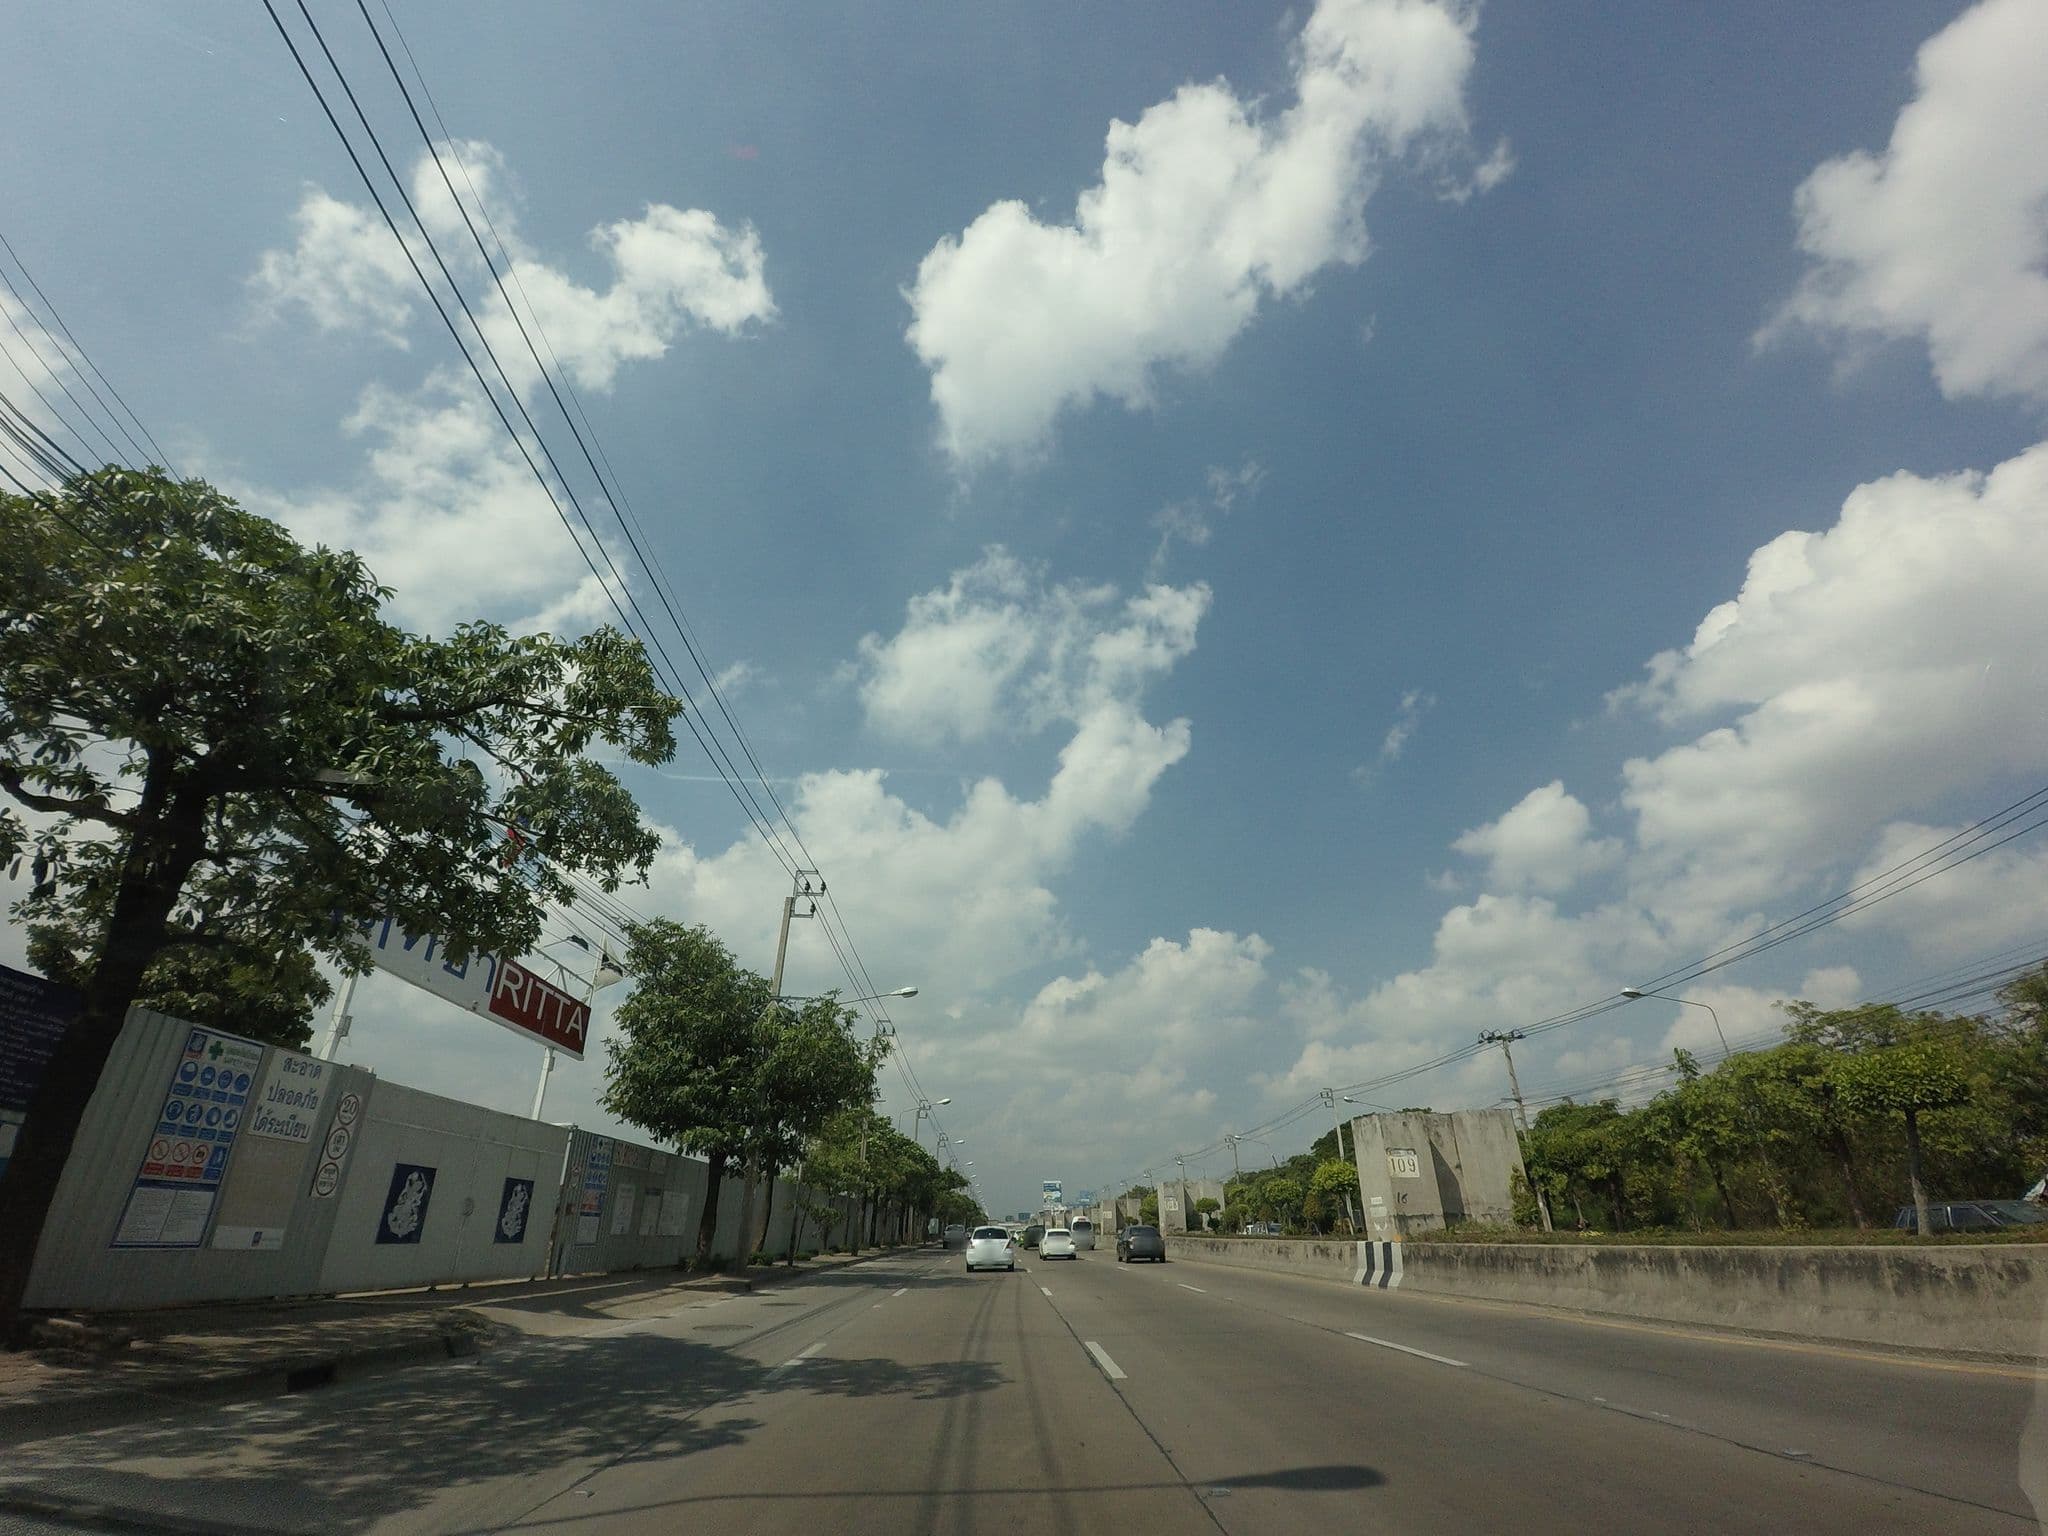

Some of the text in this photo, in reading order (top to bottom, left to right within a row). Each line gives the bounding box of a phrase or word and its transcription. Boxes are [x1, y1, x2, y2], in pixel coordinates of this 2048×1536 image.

[496, 962, 583, 1041] RITTA
[283, 1057, 322, 1079] สะอาด
[267, 1080, 319, 1110] ปลอดภัย
[342, 1099, 357, 1114] 20
[1391, 1158, 1416, 1173] 109
